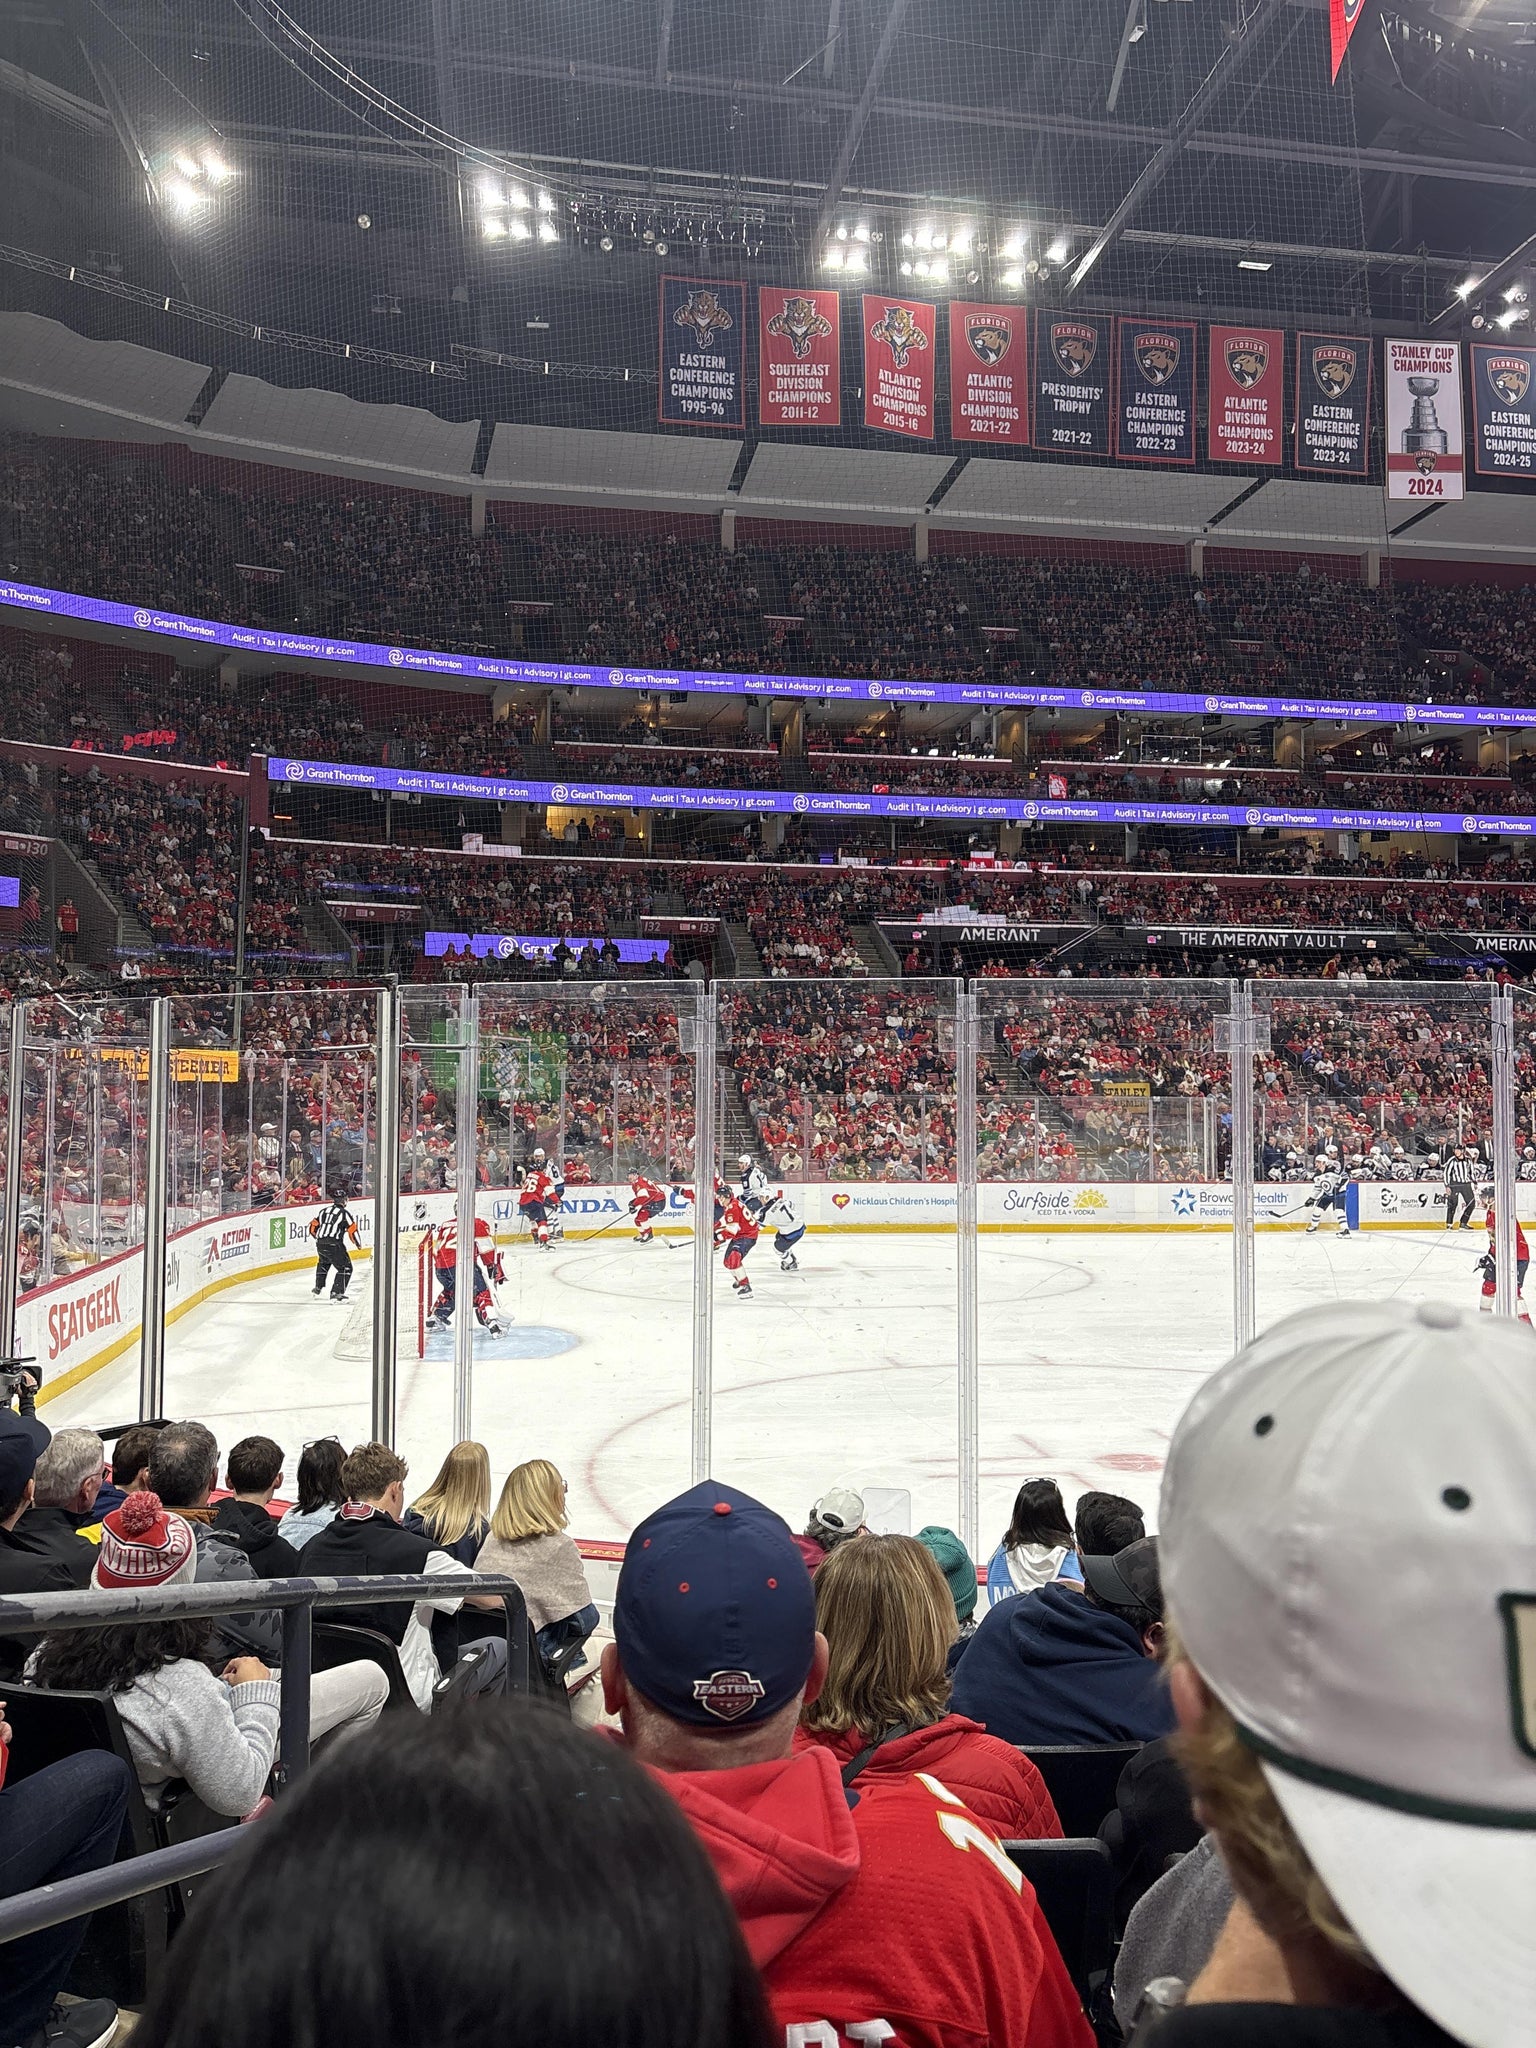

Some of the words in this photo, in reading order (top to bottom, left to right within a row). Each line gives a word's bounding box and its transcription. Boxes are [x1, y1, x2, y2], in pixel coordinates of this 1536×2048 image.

[971, 317, 1007, 328] FLORIDA
[1057, 327, 1092, 338] FLORIDA
[1140, 338, 1175, 348] FLORIDA
[1230, 342, 1264, 352] FLORIDA
[1319, 351, 1351, 360] FLORIDA
[1391, 345, 1431, 359] STANLEY
[1435, 347, 1454, 359] CUP
[679, 353, 726, 370] EASTERN
[1393, 359, 1452, 373] CHAMPIONS
[1492, 361, 1525, 371] FLORIDA
[669, 368, 736, 386] CONFERENCE
[769, 363, 829, 377] SOUTHEAST
[776, 376, 822, 390] DIVISION
[878, 369, 921, 389] ATLANTIC
[967, 374, 1012, 389] ATLANTIC
[671, 383, 733, 401] CHAMPIONS
[768, 389, 831, 404] CHAMPIONS
[879, 383, 919, 402] DIVISION
[968, 388, 1011, 404] DIVISION
[1135, 392, 1177, 407] EASTERN
[680, 399, 724, 415] 1995-96
[873, 394, 927, 417] CHAMPIONS
[960, 403, 1019, 420] CHAMPIONS
[1053, 398, 1091, 415] TROPHY
[1224, 396, 1268, 412] ATLANTIC
[781, 405, 819, 419] 2011-12
[1126, 405, 1186, 422] CONFERENCE
[1225, 411, 1267, 425] DIVISION
[1312, 405, 1353, 420] EASTERN
[1491, 411, 1531, 425] EASTERN
[883, 412, 918, 429] 2015-16
[970, 419, 1010, 435] 2021-22
[1304, 418, 1361, 435] CONFERENCE
[1127, 421, 1184, 437] CHAMPIONS
[1218, 424, 1274, 441] CHAMPIONS
[1052, 430, 1092, 444] 2021-22
[1135, 436, 1176, 451] 2022-23
[1305, 434, 1358, 449] CHAMPIONS
[1226, 440, 1265, 455] 2023-24
[1313, 449, 1350, 463] 2023-24
[1493, 453, 1531, 467] 2024-25
[1408, 479, 1444, 495] 2024
[231, 632, 255, 645] Audit
[261, 637, 276, 646] Tax
[282, 639, 320, 654] Advisory
[325, 646, 355, 656] gt.com
[477, 663, 500, 673] Audit
[504, 666, 518, 675] Tax
[523, 668, 559, 680] Advisory
[563, 671, 591, 681] gt.com
[744, 680, 765, 689] Audit
[770, 681, 784, 689] Tax
[788, 682, 822, 693] Advisory
[826, 685, 852, 694] gt.com
[961, 690, 982, 698] Audit
[986, 690, 999, 699] Tax
[1004, 691, 1036, 702] Advisory
[1040, 694, 1066, 702] gt.com
[1280, 704, 1300, 712] Audit
[1304, 705, 1316, 713] Tax
[1320, 706, 1350, 716] Advisory
[1353, 708, 1378, 716] gt.com
[1476, 712, 1495, 720] Audit
[1499, 713, 1511, 721] Tax
[397, 776, 423, 789] Audit
[429, 779, 445, 789] Tax
[451, 781, 492, 795] Advisory
[497, 787, 529, 797] gt.com
[650, 793, 675, 804] Audit
[680, 794, 695, 804] Tax
[701, 795, 740, 807] Advisory
[745, 798, 775, 808] gt.com
[886, 802, 910, 812] Audit
[915, 803, 930, 812] Tax
[935, 803, 972, 815] Advisory
[977, 806, 1007, 816] gt.com
[1114, 809, 1136, 818] Audit
[1141, 809, 1156, 818] Tax
[1160, 810, 1197, 821] Advisory
[1201, 812, 1230, 822] gt.com
[1332, 815, 1354, 826] Audit
[1358, 816, 1372, 825] Tax
[1376, 817, 1410, 829] Advisory
[1415, 819, 1442, 829] gt.com
[27, 842, 48, 855] 130
[644, 921, 661, 932] 132
[699, 922, 716, 933] 133
[960, 928, 1040, 941] AMERANT
[1179, 932, 1207, 946] THE
[1212, 933, 1289, 947] AMERANT
[1295, 935, 1346, 948] VAULT
[1475, 938, 1536, 951] AMERAN
[1103, 1087, 1146, 1097] STANLEY
[853, 1198, 888, 1206] Nicklaus
[889, 1197, 929, 1206] Children's
[1004, 1189, 1070, 1210] Surfside
[221, 1228, 251, 1247] ACTION
[48, 1274, 121, 1360] SEATGEEK
[699, 1685, 759, 1694] EASTERN
